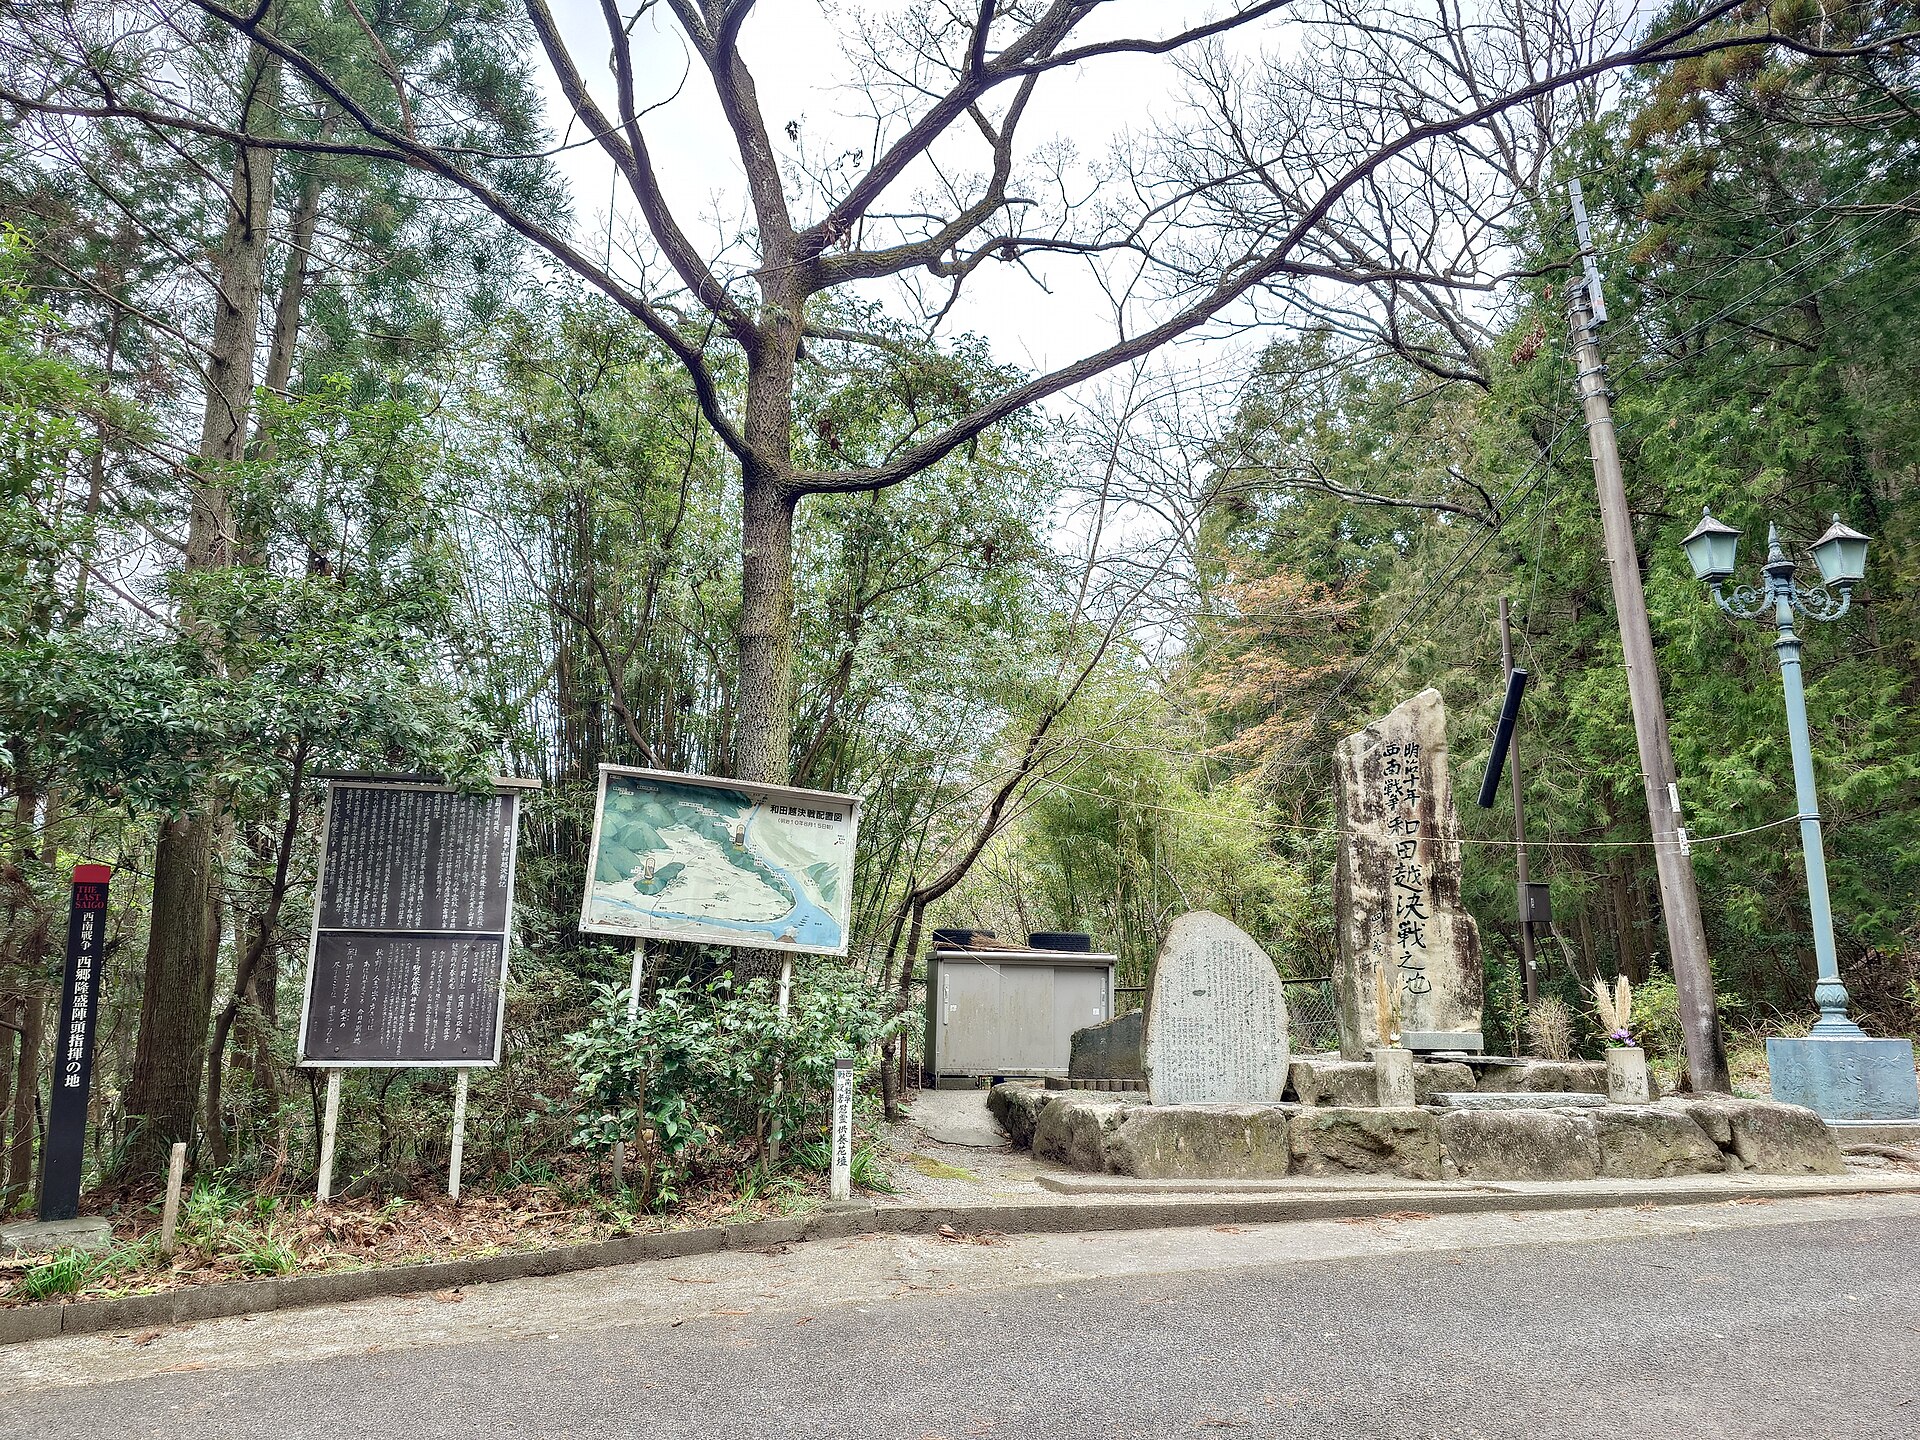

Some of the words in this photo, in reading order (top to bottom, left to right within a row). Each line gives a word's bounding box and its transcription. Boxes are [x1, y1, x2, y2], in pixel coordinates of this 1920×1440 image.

[1403, 742, 1420, 807] 明治十年
[770, 804, 843, 823] 和田越決戦配置図
[76, 893, 101, 901] LAST
[78, 885, 97, 894] THE
[75, 901, 105, 909] SAIGO
[80, 911, 95, 951] 西南戦争
[64, 955, 93, 1088] 西郷隆盛陣頭指揮の地
